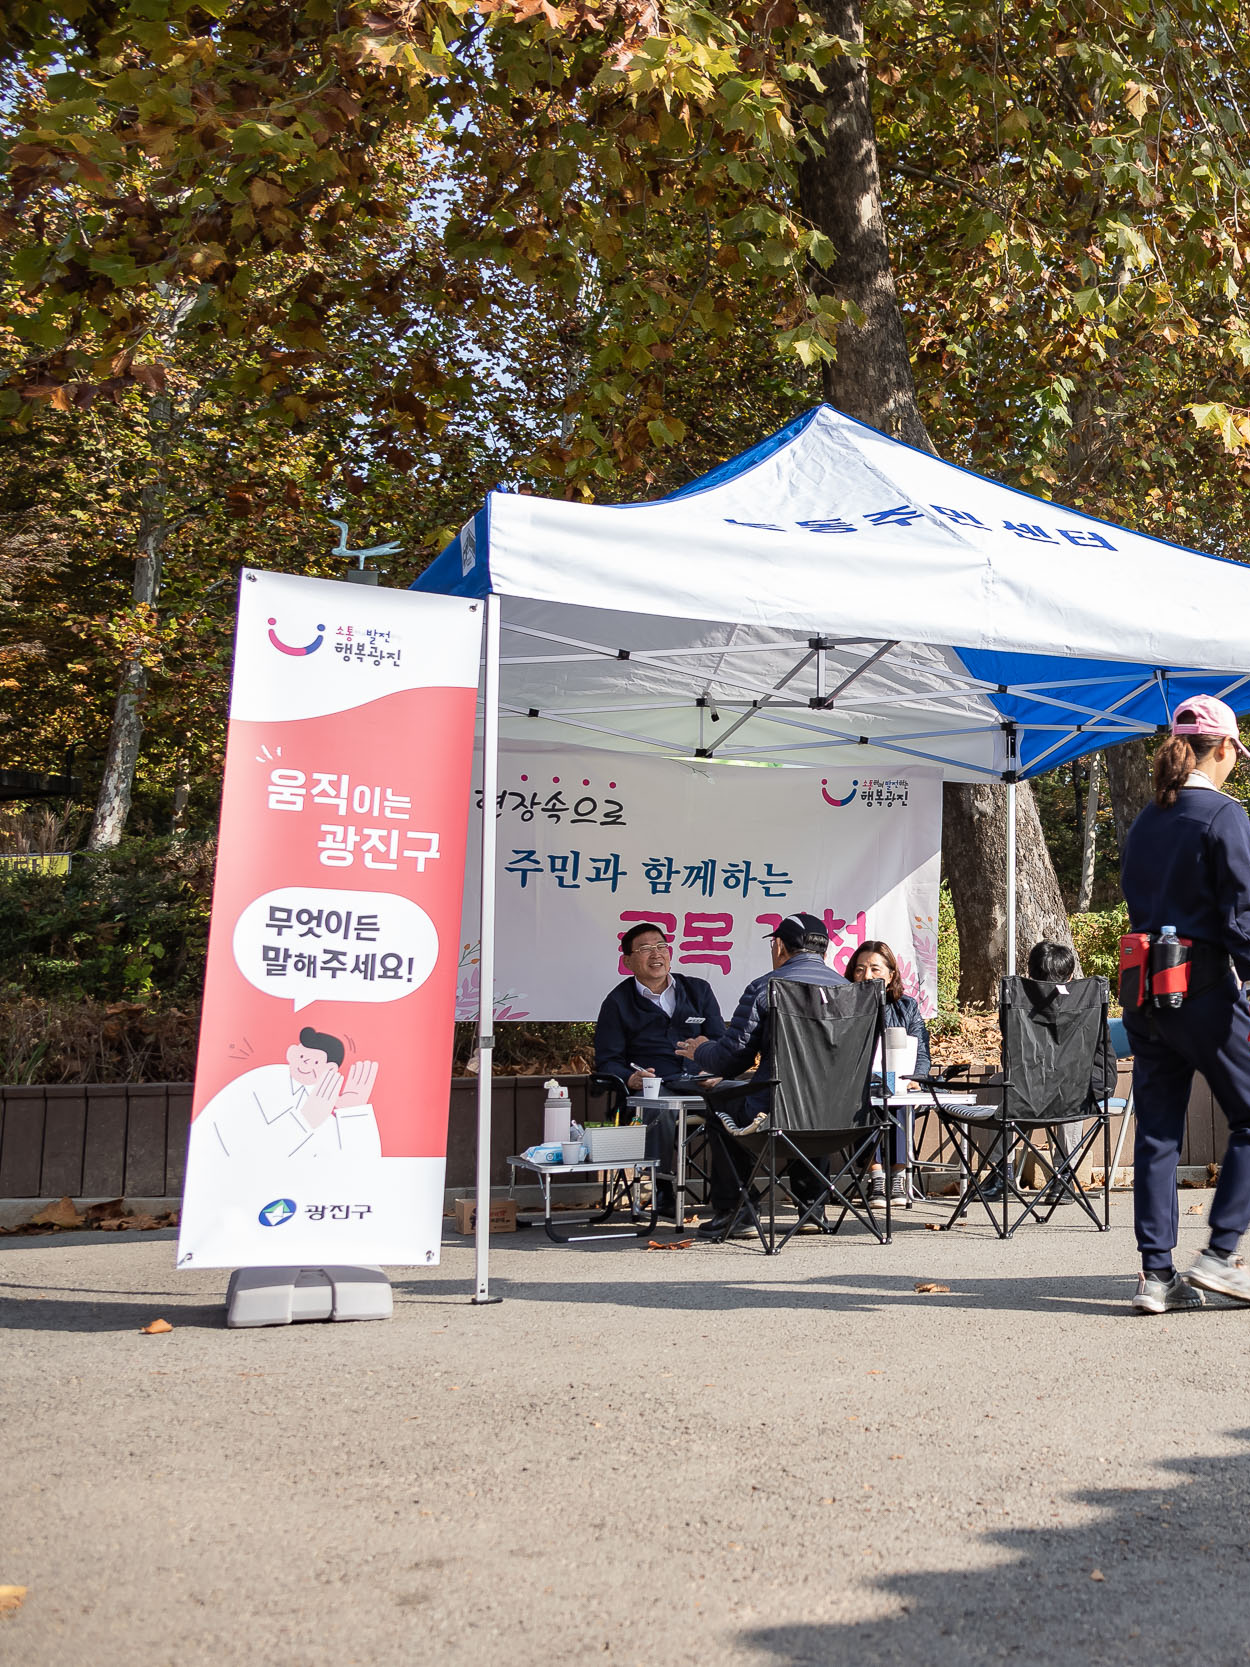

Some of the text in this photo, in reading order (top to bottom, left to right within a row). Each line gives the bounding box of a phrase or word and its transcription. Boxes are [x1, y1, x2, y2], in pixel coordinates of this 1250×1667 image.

[334, 643, 401, 667] 행복광진
[267, 768, 412, 820] 움직이는
[861, 789, 909, 807] 행복광진
[317, 824, 441, 873] 광진구
[504, 849, 793, 898] 주민과 함께하는
[265, 906, 381, 941] 무엇이든
[755, 908, 867, 977] 청
[262, 945, 414, 982] 말해주세요!
[304, 1204, 373, 1221] 광진구
